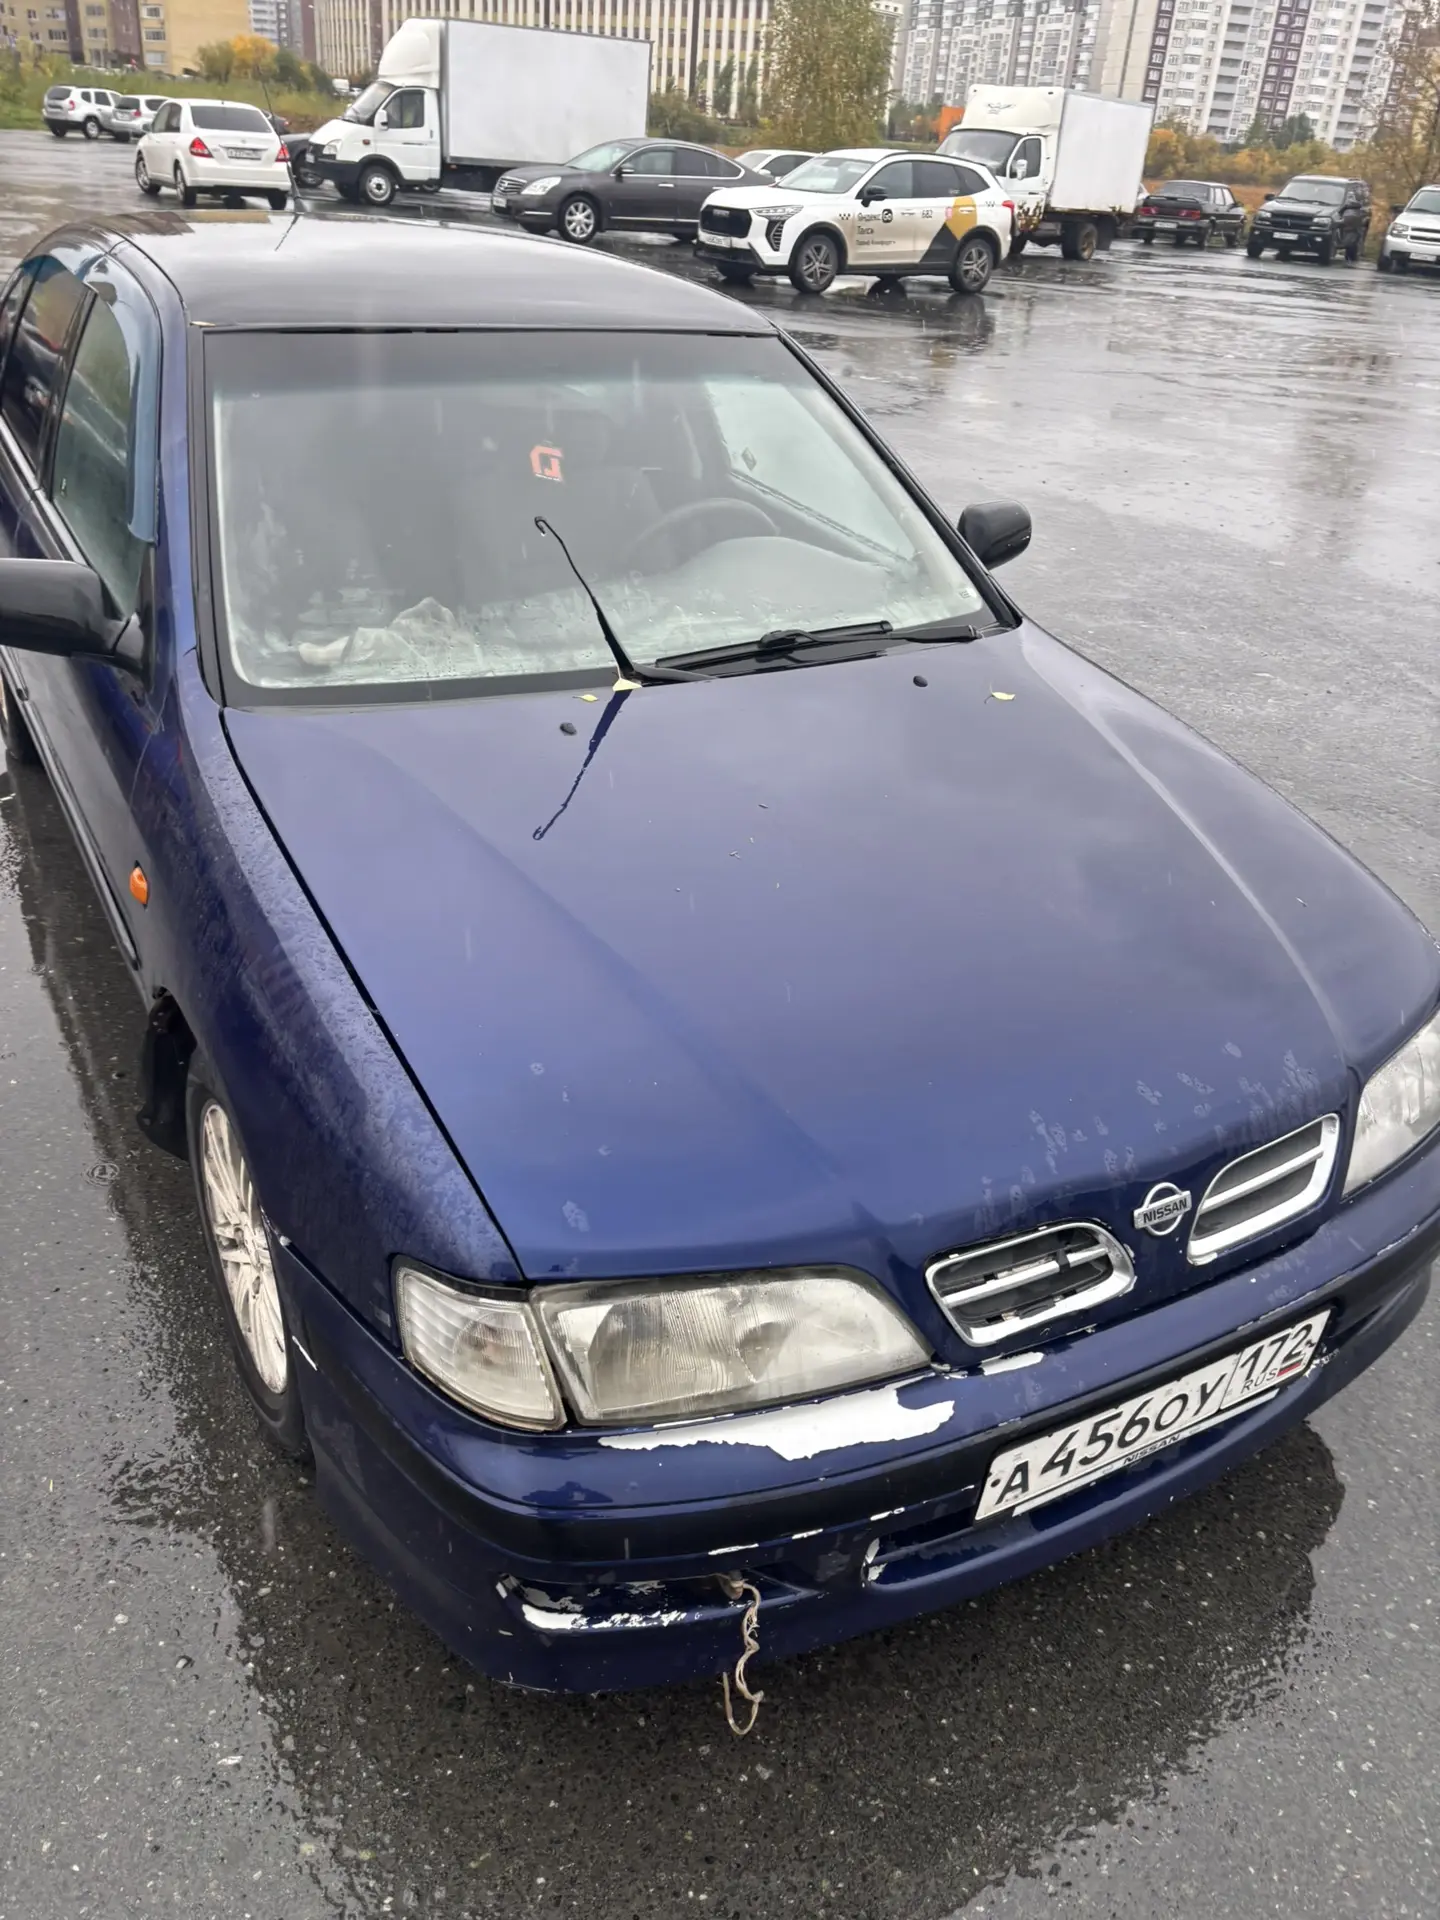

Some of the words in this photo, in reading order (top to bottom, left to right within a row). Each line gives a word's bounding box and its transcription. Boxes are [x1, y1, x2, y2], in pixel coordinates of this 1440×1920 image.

[1143, 1197, 1187, 1224] NISSAN
[1239, 1323, 1313, 1381] 172
[1240, 1367, 1279, 1394] RUS
[1122, 1433, 1181, 1465] NISSAN
